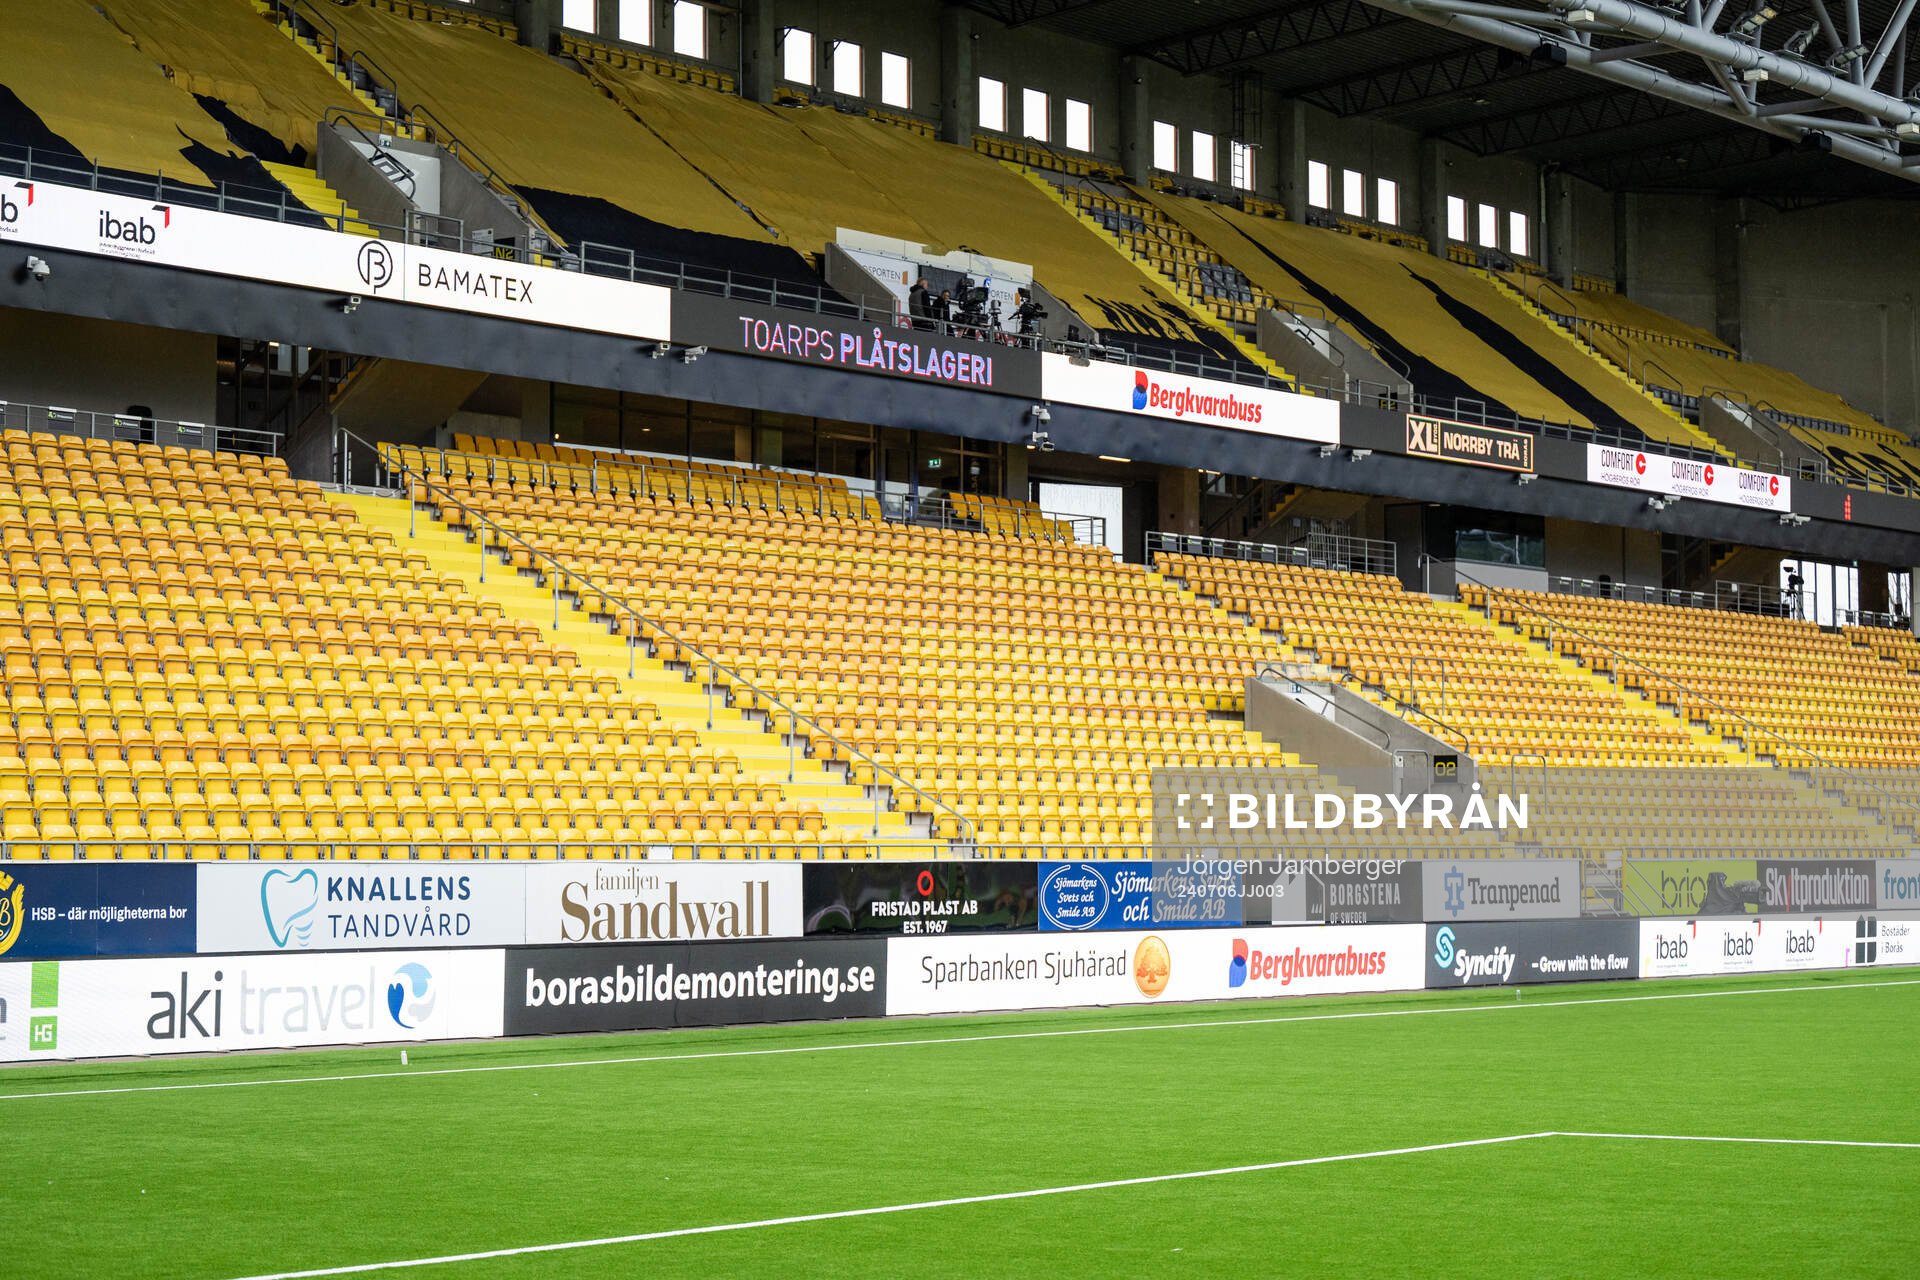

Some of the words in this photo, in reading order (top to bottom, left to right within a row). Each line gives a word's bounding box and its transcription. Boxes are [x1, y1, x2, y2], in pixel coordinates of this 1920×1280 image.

[100, 210, 156, 245] ibab
[418, 263, 533, 304] BAMATEX
[739, 316, 834, 361] TOARPS
[840, 327, 992, 386] PLÅTSLAGERI
[1150, 382, 1262, 423] Bergkvarabuss
[1408, 419, 1438, 453] XL
[1443, 431, 1494, 456] NORRBY
[1496, 438, 1520, 461] TRÄ
[1601, 449, 1634, 471] COMFORT
[1672, 461, 1703, 482] COMFORT
[1739, 472, 1768, 493] COMFORT
[327, 876, 471, 901] KNALLENS
[594, 867, 660, 898] familjen
[1054, 876, 1097, 890] Sjömarkens
[1111, 868, 1194, 902] Sjömarkens
[1329, 882, 1400, 906] BORGSTENA
[1468, 877, 1561, 911] Tranpenad
[1765, 867, 1870, 913] Skyltproduktion
[561, 880, 773, 942] Sandwall
[872, 901, 921, 916] FRISTAD
[923, 900, 959, 916] PLAST
[962, 900, 978, 915] AB
[1057, 892, 1079, 903] Svets
[1081, 892, 1094, 902] och
[1123, 897, 1150, 922] och
[1152, 898, 1197, 922] Smide
[1200, 898, 1226, 919] AB
[31, 907, 56, 921] HSB
[67, 907, 87, 921] där
[89, 906, 167, 923] möjligheterna
[169, 906, 188, 919] bor
[328, 906, 471, 938] TANDVÅRD
[1055, 907, 1081, 919] Smide
[1081, 906, 1095, 917] AB
[1330, 912, 1338, 925] OF
[1340, 911, 1367, 924] SWEDEN
[903, 921, 924, 934] EST.
[925, 920, 947, 933] 1967
[1655, 934, 1688, 960] ibab
[1723, 932, 1754, 957] ibab
[1786, 930, 1815, 955] ibab
[921, 952, 1037, 990] Sparbanken
[1044, 948, 1127, 986] Sjuhärad
[1250, 944, 1386, 985] Bergkvarabuss
[1454, 946, 1515, 984] Syncify
[1568, 955, 1587, 971] with
[1589, 954, 1606, 970] the
[1608, 953, 1629, 969] flow
[525, 959, 875, 1007] borasbildemontering.se
[146, 970, 224, 1040] aki
[239, 965, 376, 1035] travel
[34, 1024, 53, 1042] HG
